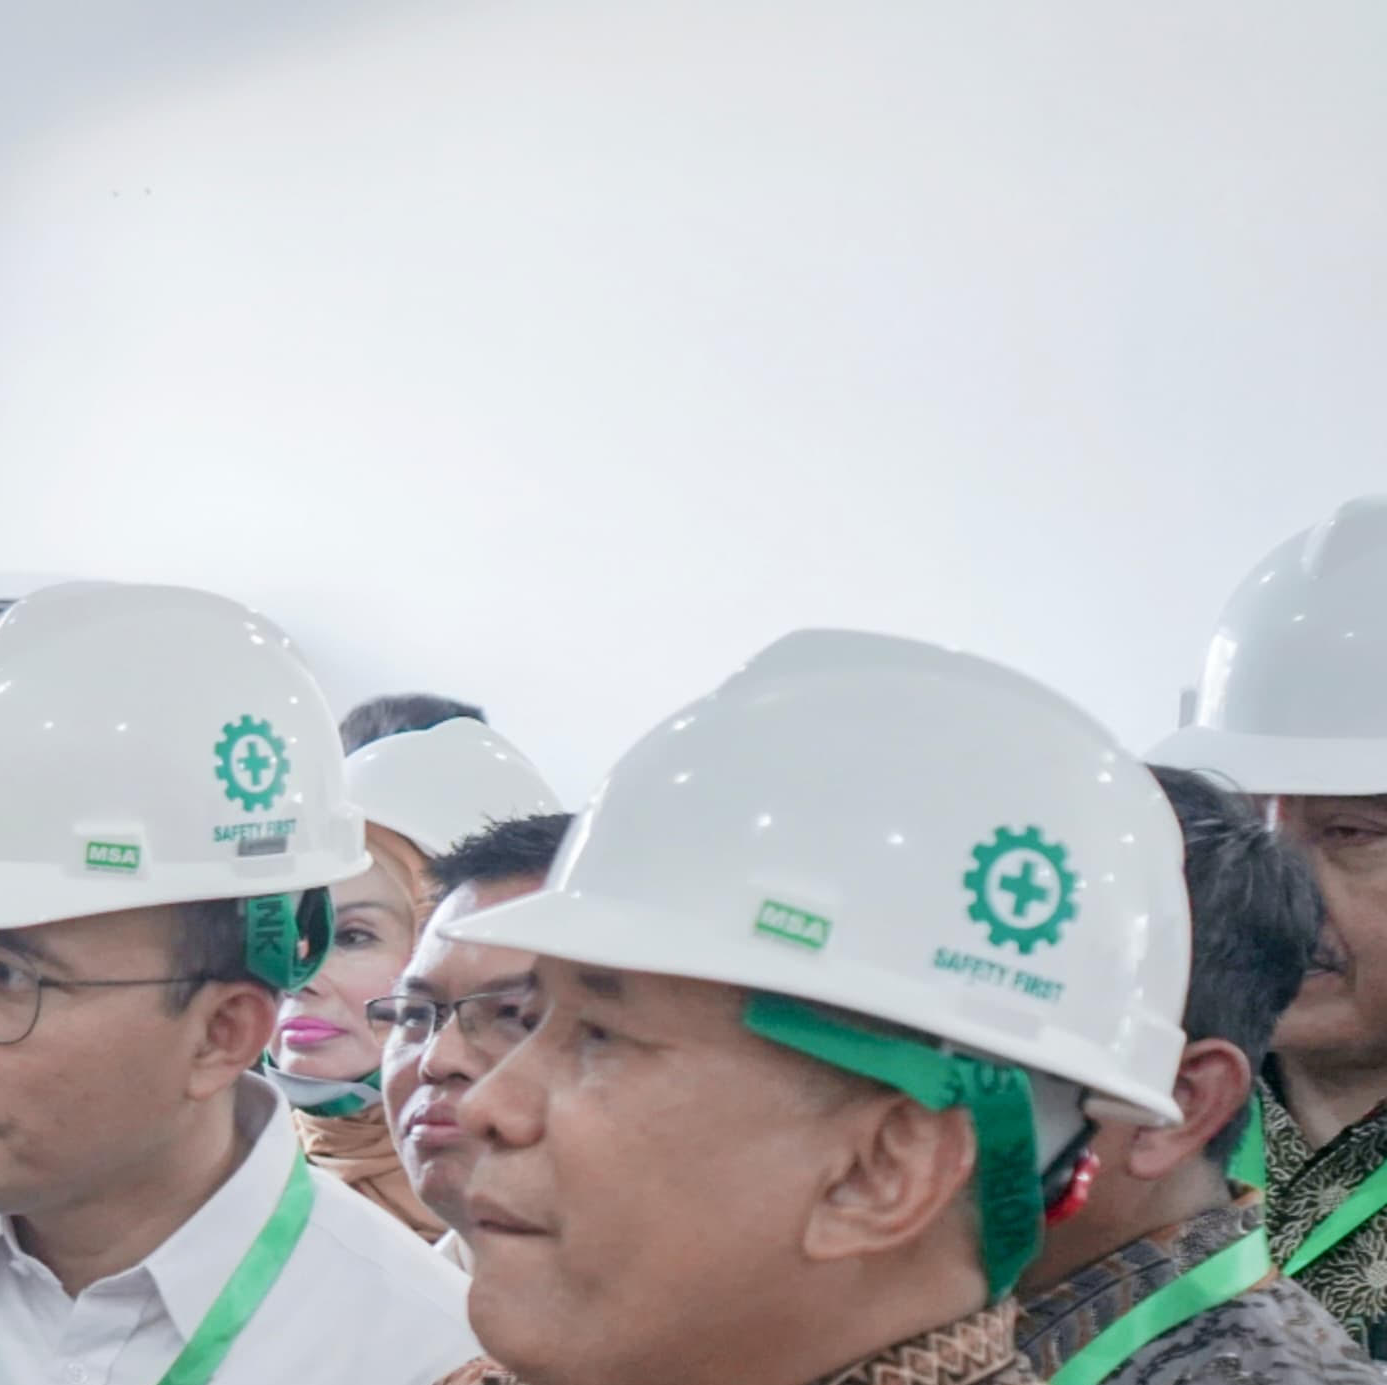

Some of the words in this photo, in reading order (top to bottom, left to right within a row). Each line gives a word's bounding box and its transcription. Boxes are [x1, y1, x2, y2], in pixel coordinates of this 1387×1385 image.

[213, 823, 261, 842] SAFETY
[266, 818, 297, 835] FIRST
[89, 845, 137, 864] MSA
[763, 905, 826, 939] MSA
[934, 948, 1007, 987] SAFETY
[1014, 973, 1064, 1002] FIRST
